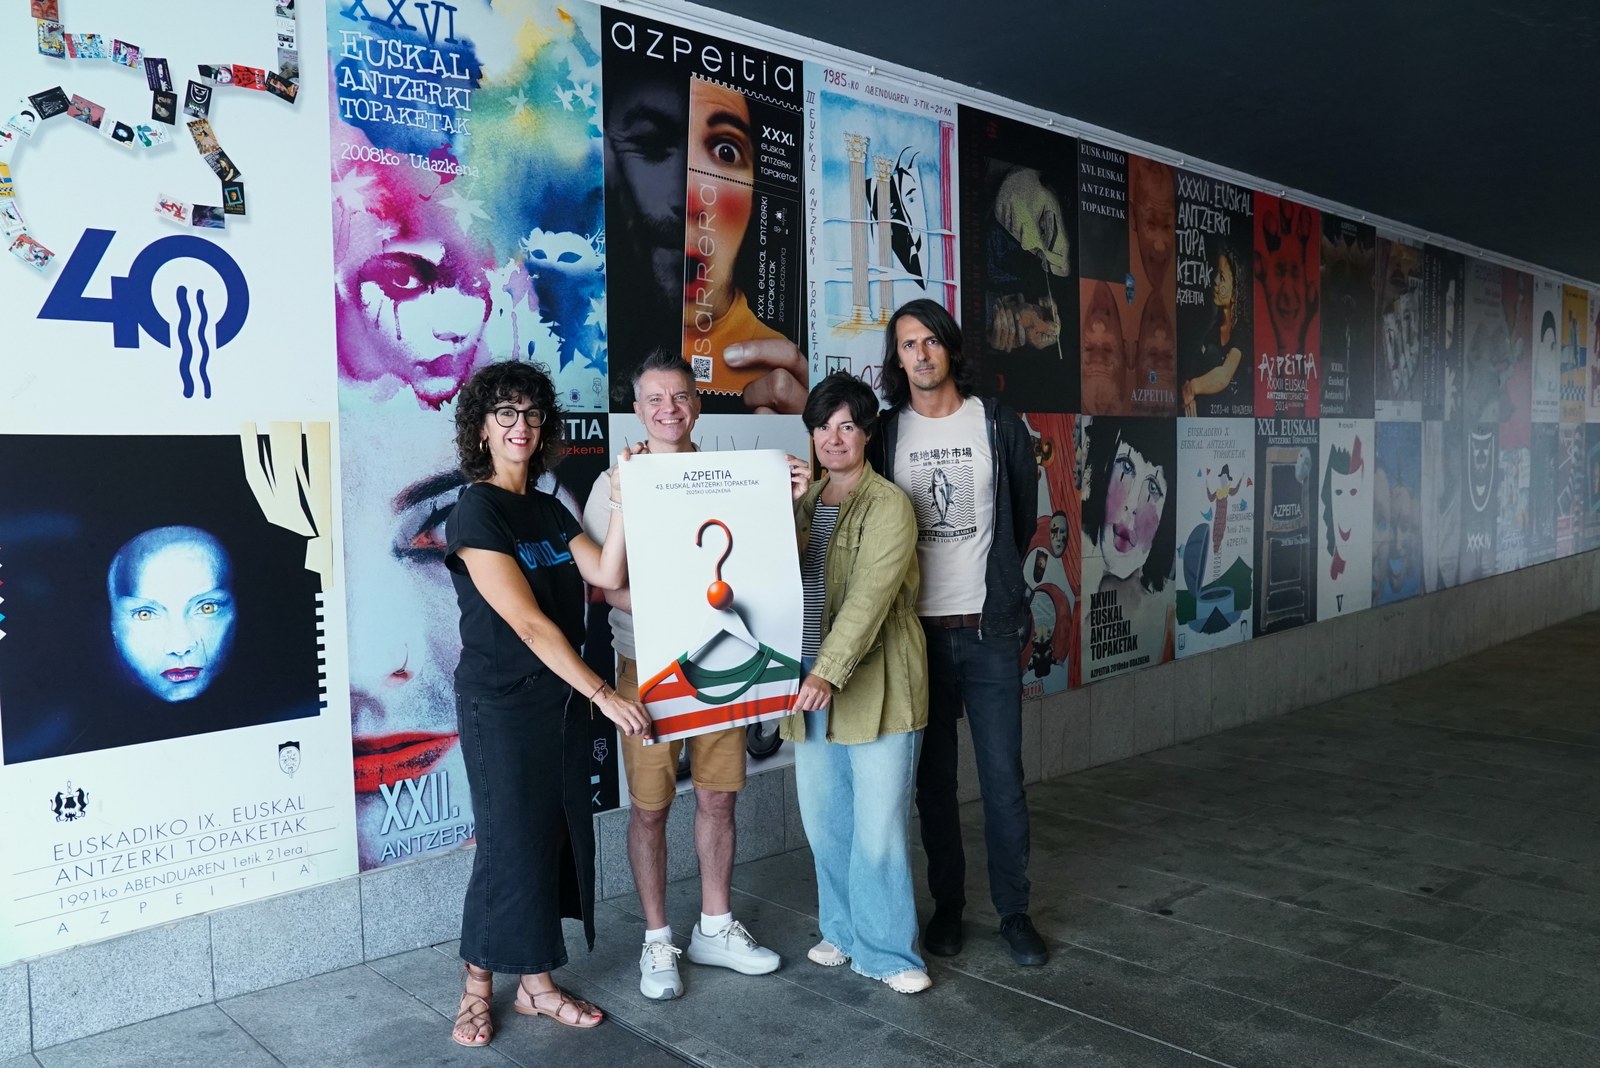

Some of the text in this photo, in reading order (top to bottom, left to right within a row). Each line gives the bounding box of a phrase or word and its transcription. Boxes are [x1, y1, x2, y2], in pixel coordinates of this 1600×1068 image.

[339, 29, 470, 81] EUSKAL
[339, 66, 472, 112] ANTZERKI
[865, 84, 910, 105] ABENDUAREN
[340, 97, 472, 136] TOPAKETAK
[762, 125, 795, 147] XXXI.
[808, 108, 817, 172] EUSKAL
[341, 143, 479, 178] 2008ko Udazkena
[1080, 143, 1125, 165] EUSKADIKO
[1097, 165, 1126, 183] EUSKAL
[1080, 182, 1126, 201] ANTZERKI
[1080, 201, 1126, 220] TOPAKETAK
[809, 187, 818, 266] ANTZERKI
[1176, 228, 1206, 260] TOPA
[1176, 256, 1214, 289] KETAK
[37, 227, 250, 350] 40
[809, 281, 820, 374] TOPAKETAK
[1131, 388, 1175, 403] AZPEITIA
[1284, 378, 1309, 392] EUSKAL
[560, 418, 604, 440] ITIA
[1257, 418, 1278, 436] XXI.
[1280, 418, 1318, 436] EUSKAL
[666, 481, 691, 490] EUSKAL
[691, 480, 723, 489] ANTZERKI
[724, 479, 760, 487] TOPAKETAK
[682, 469, 732, 482] AZPEITIA
[1273, 503, 1302, 518] AZPEITIA
[1090, 605, 1123, 627] EUSKAL
[1090, 620, 1131, 644] ANTZERKI
[1090, 634, 1138, 661] TOPAKETAK
[379, 771, 460, 836] XXII.
[54, 795, 306, 862] EUSKADIKO IX. EUSKAL
[380, 821, 475, 862] ANTZERK
[55, 816, 307, 886] ANTZERKI TOPAKETAK
[58, 887, 118, 910] 1991ko
[123, 861, 225, 894] ABENDUAREN
